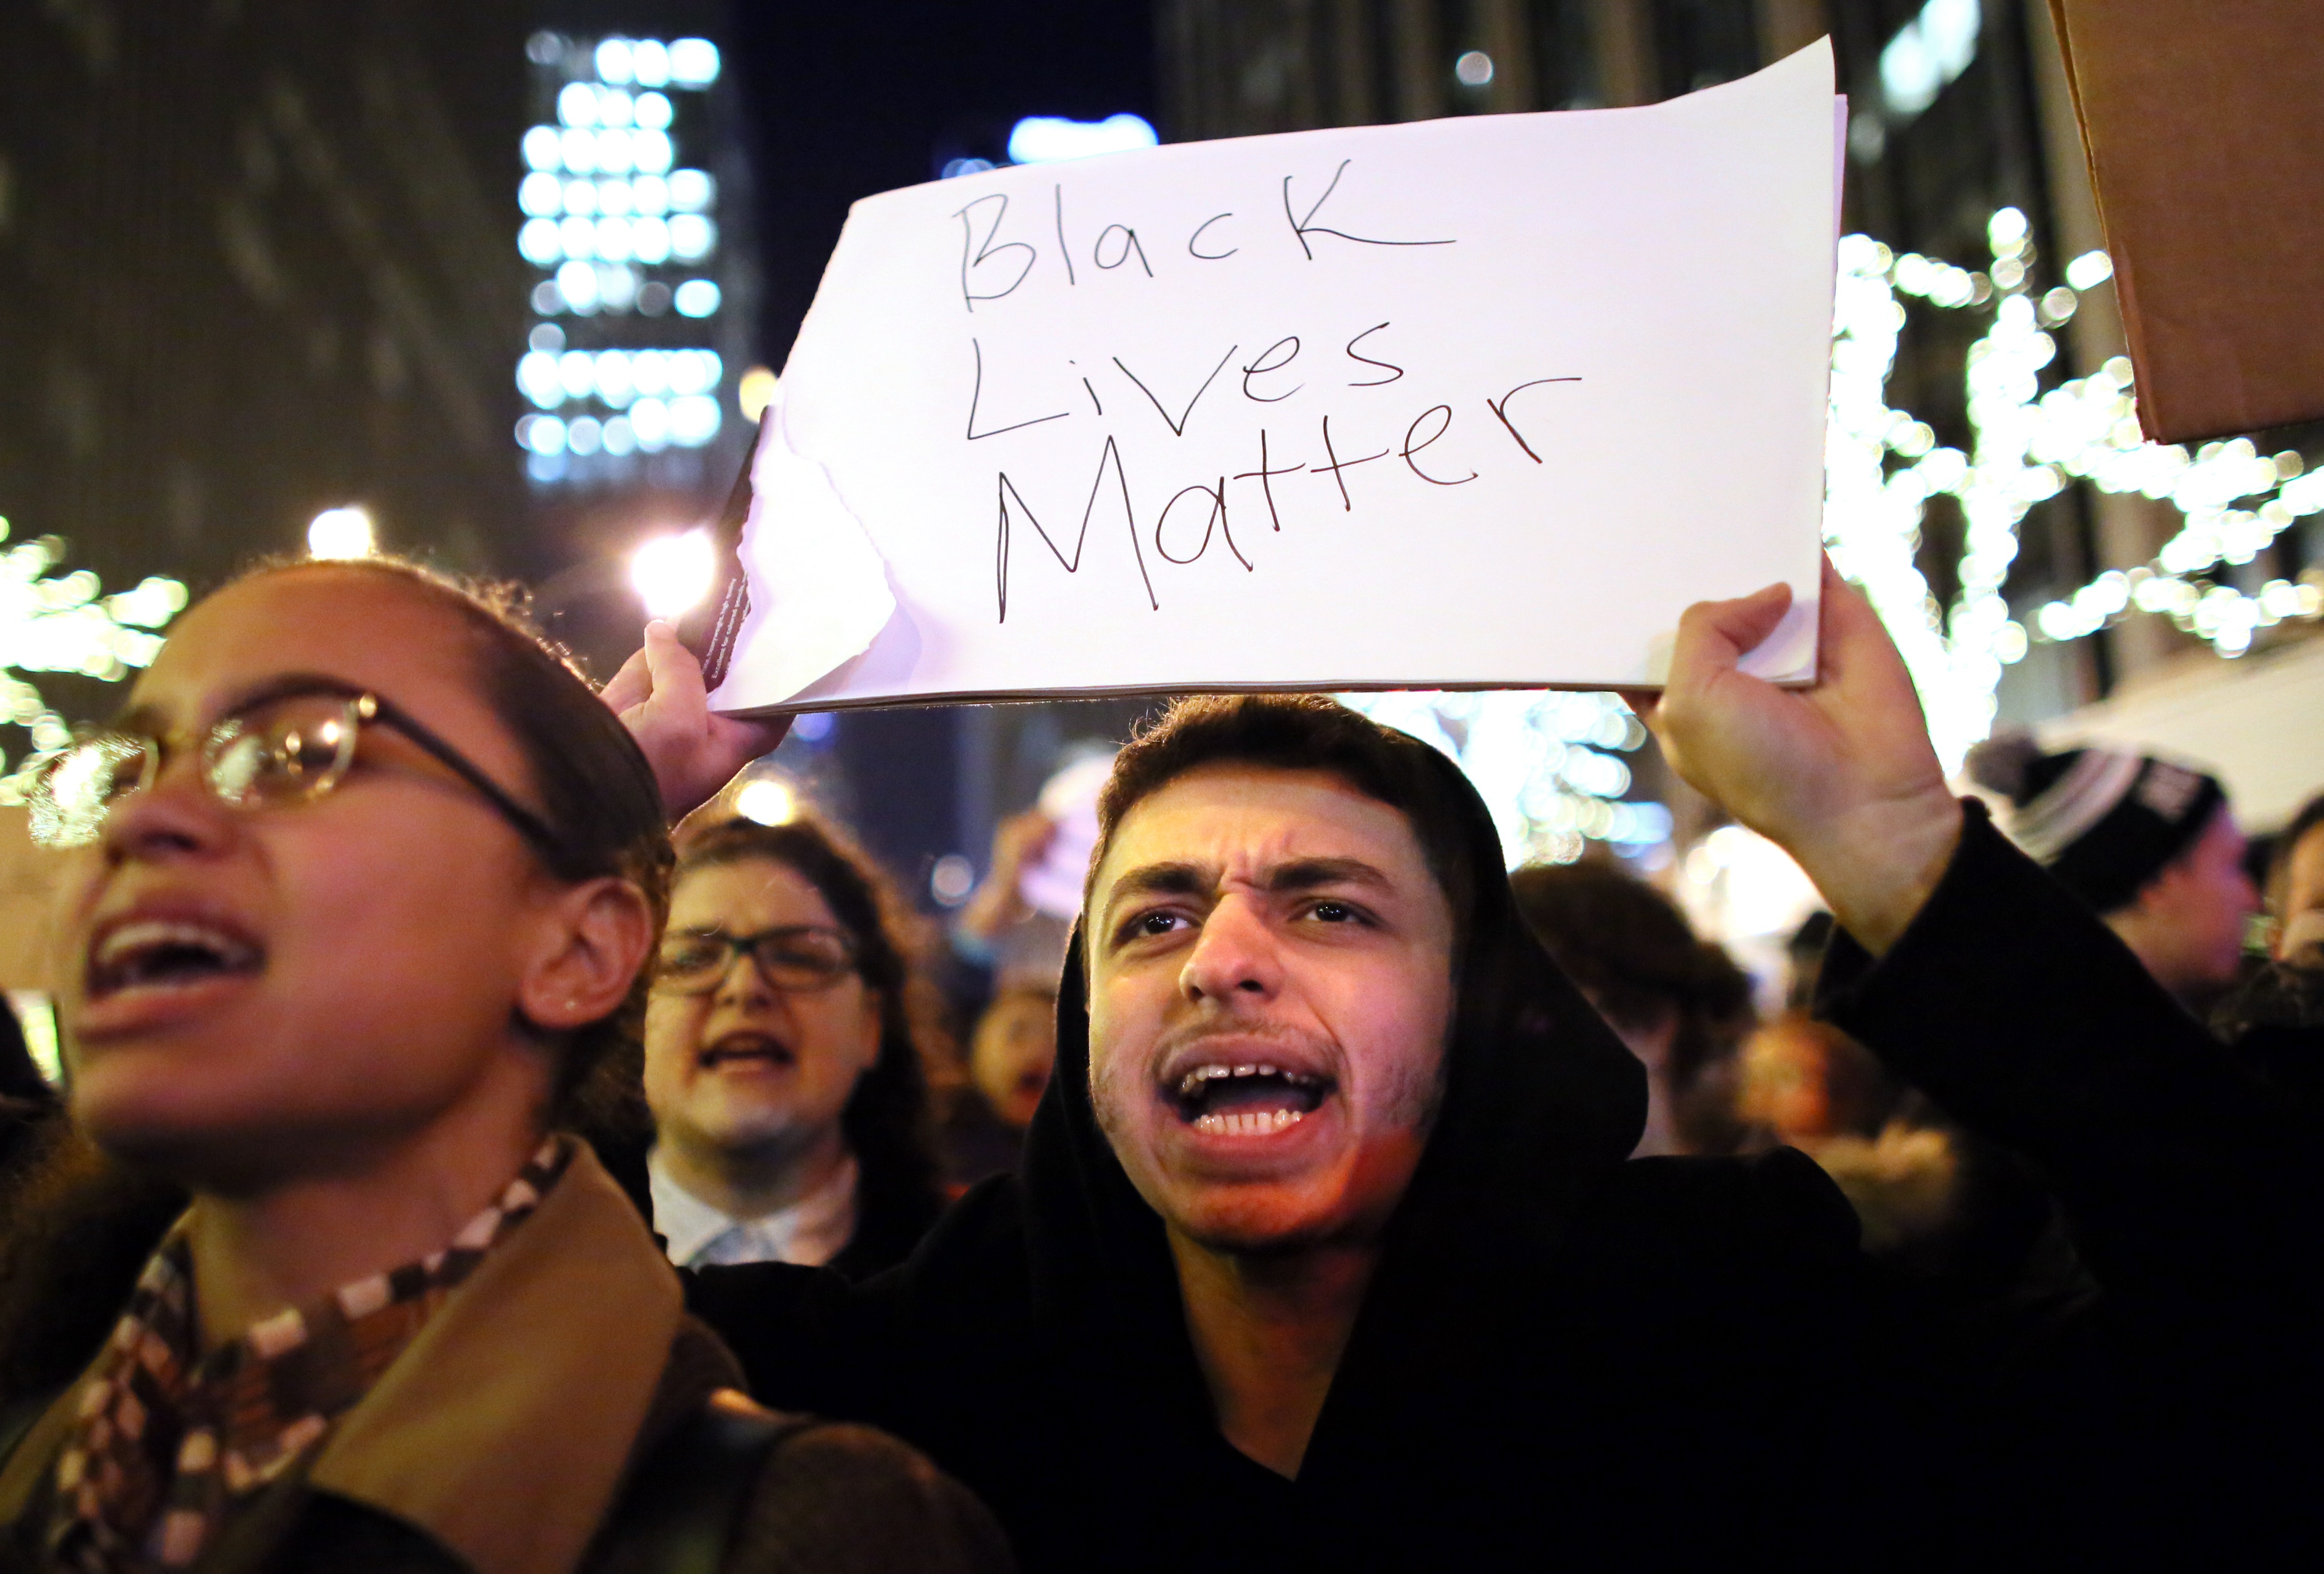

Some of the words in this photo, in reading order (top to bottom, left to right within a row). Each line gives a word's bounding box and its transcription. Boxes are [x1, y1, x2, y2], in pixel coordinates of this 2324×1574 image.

[967, 321, 1404, 440] Lives
[996, 377, 1583, 624] Matter
[711, 647, 726, 678] Excellent
